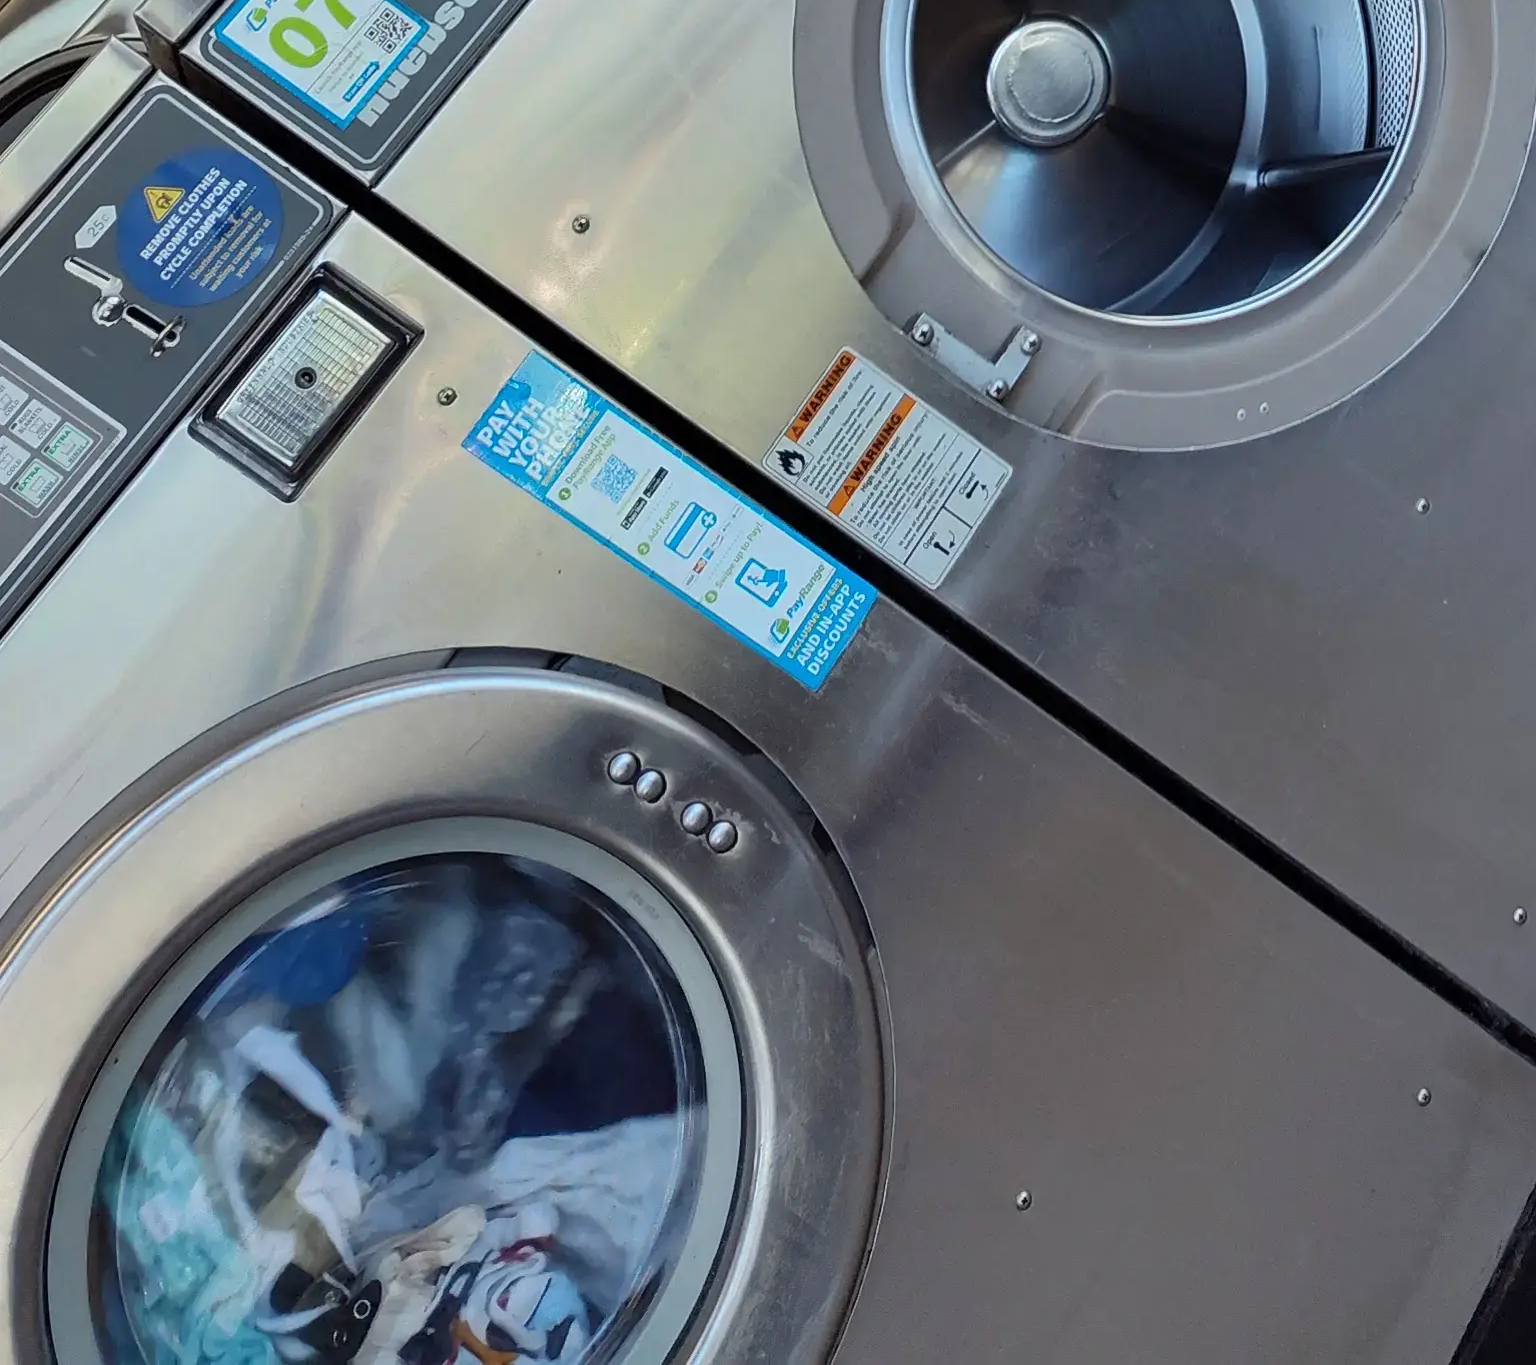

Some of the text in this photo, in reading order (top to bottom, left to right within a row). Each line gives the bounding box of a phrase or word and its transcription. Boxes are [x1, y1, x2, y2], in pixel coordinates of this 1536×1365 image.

[138, 165, 222, 261] REMOVE CLOTHES
[152, 176, 232, 267] PROMPTLY UPON
[158, 178, 249, 283] CYCLE COMPLETION
[187, 235, 229, 281] Unattended
[241, 203, 255, 220] are
[196, 208, 264, 288] subject to removal for
[206, 217, 272, 294] waiting customers at
[233, 244, 264, 280] your risk
[475, 398, 517, 448] PAY
[798, 352, 853, 425] WARNING
[48, 428, 73, 455] EXTRA
[491, 394, 545, 461] WITH
[507, 402, 564, 472] YOUR
[524, 398, 592, 483] PHONE
[564, 423, 612, 485] Download Free
[571, 431, 617, 491] PayRange App
[848, 410, 903, 484] WARNING
[16, 465, 42, 492] EXTRA
[36, 479, 55, 500] WASH
[859, 434, 903, 494] High speed spin
[957, 470, 977, 496] Closed
[646, 497, 681, 542] Add Funds
[921, 529, 939, 551] Open
[714, 520, 764, 591] Swipe up to Pay!
[784, 562, 828, 620] PayRange
[785, 575, 844, 660] EXCLUSIVE OFFERS
[794, 583, 855, 667] AND IN-APP
[805, 589, 868, 676] DISCOUNTS
